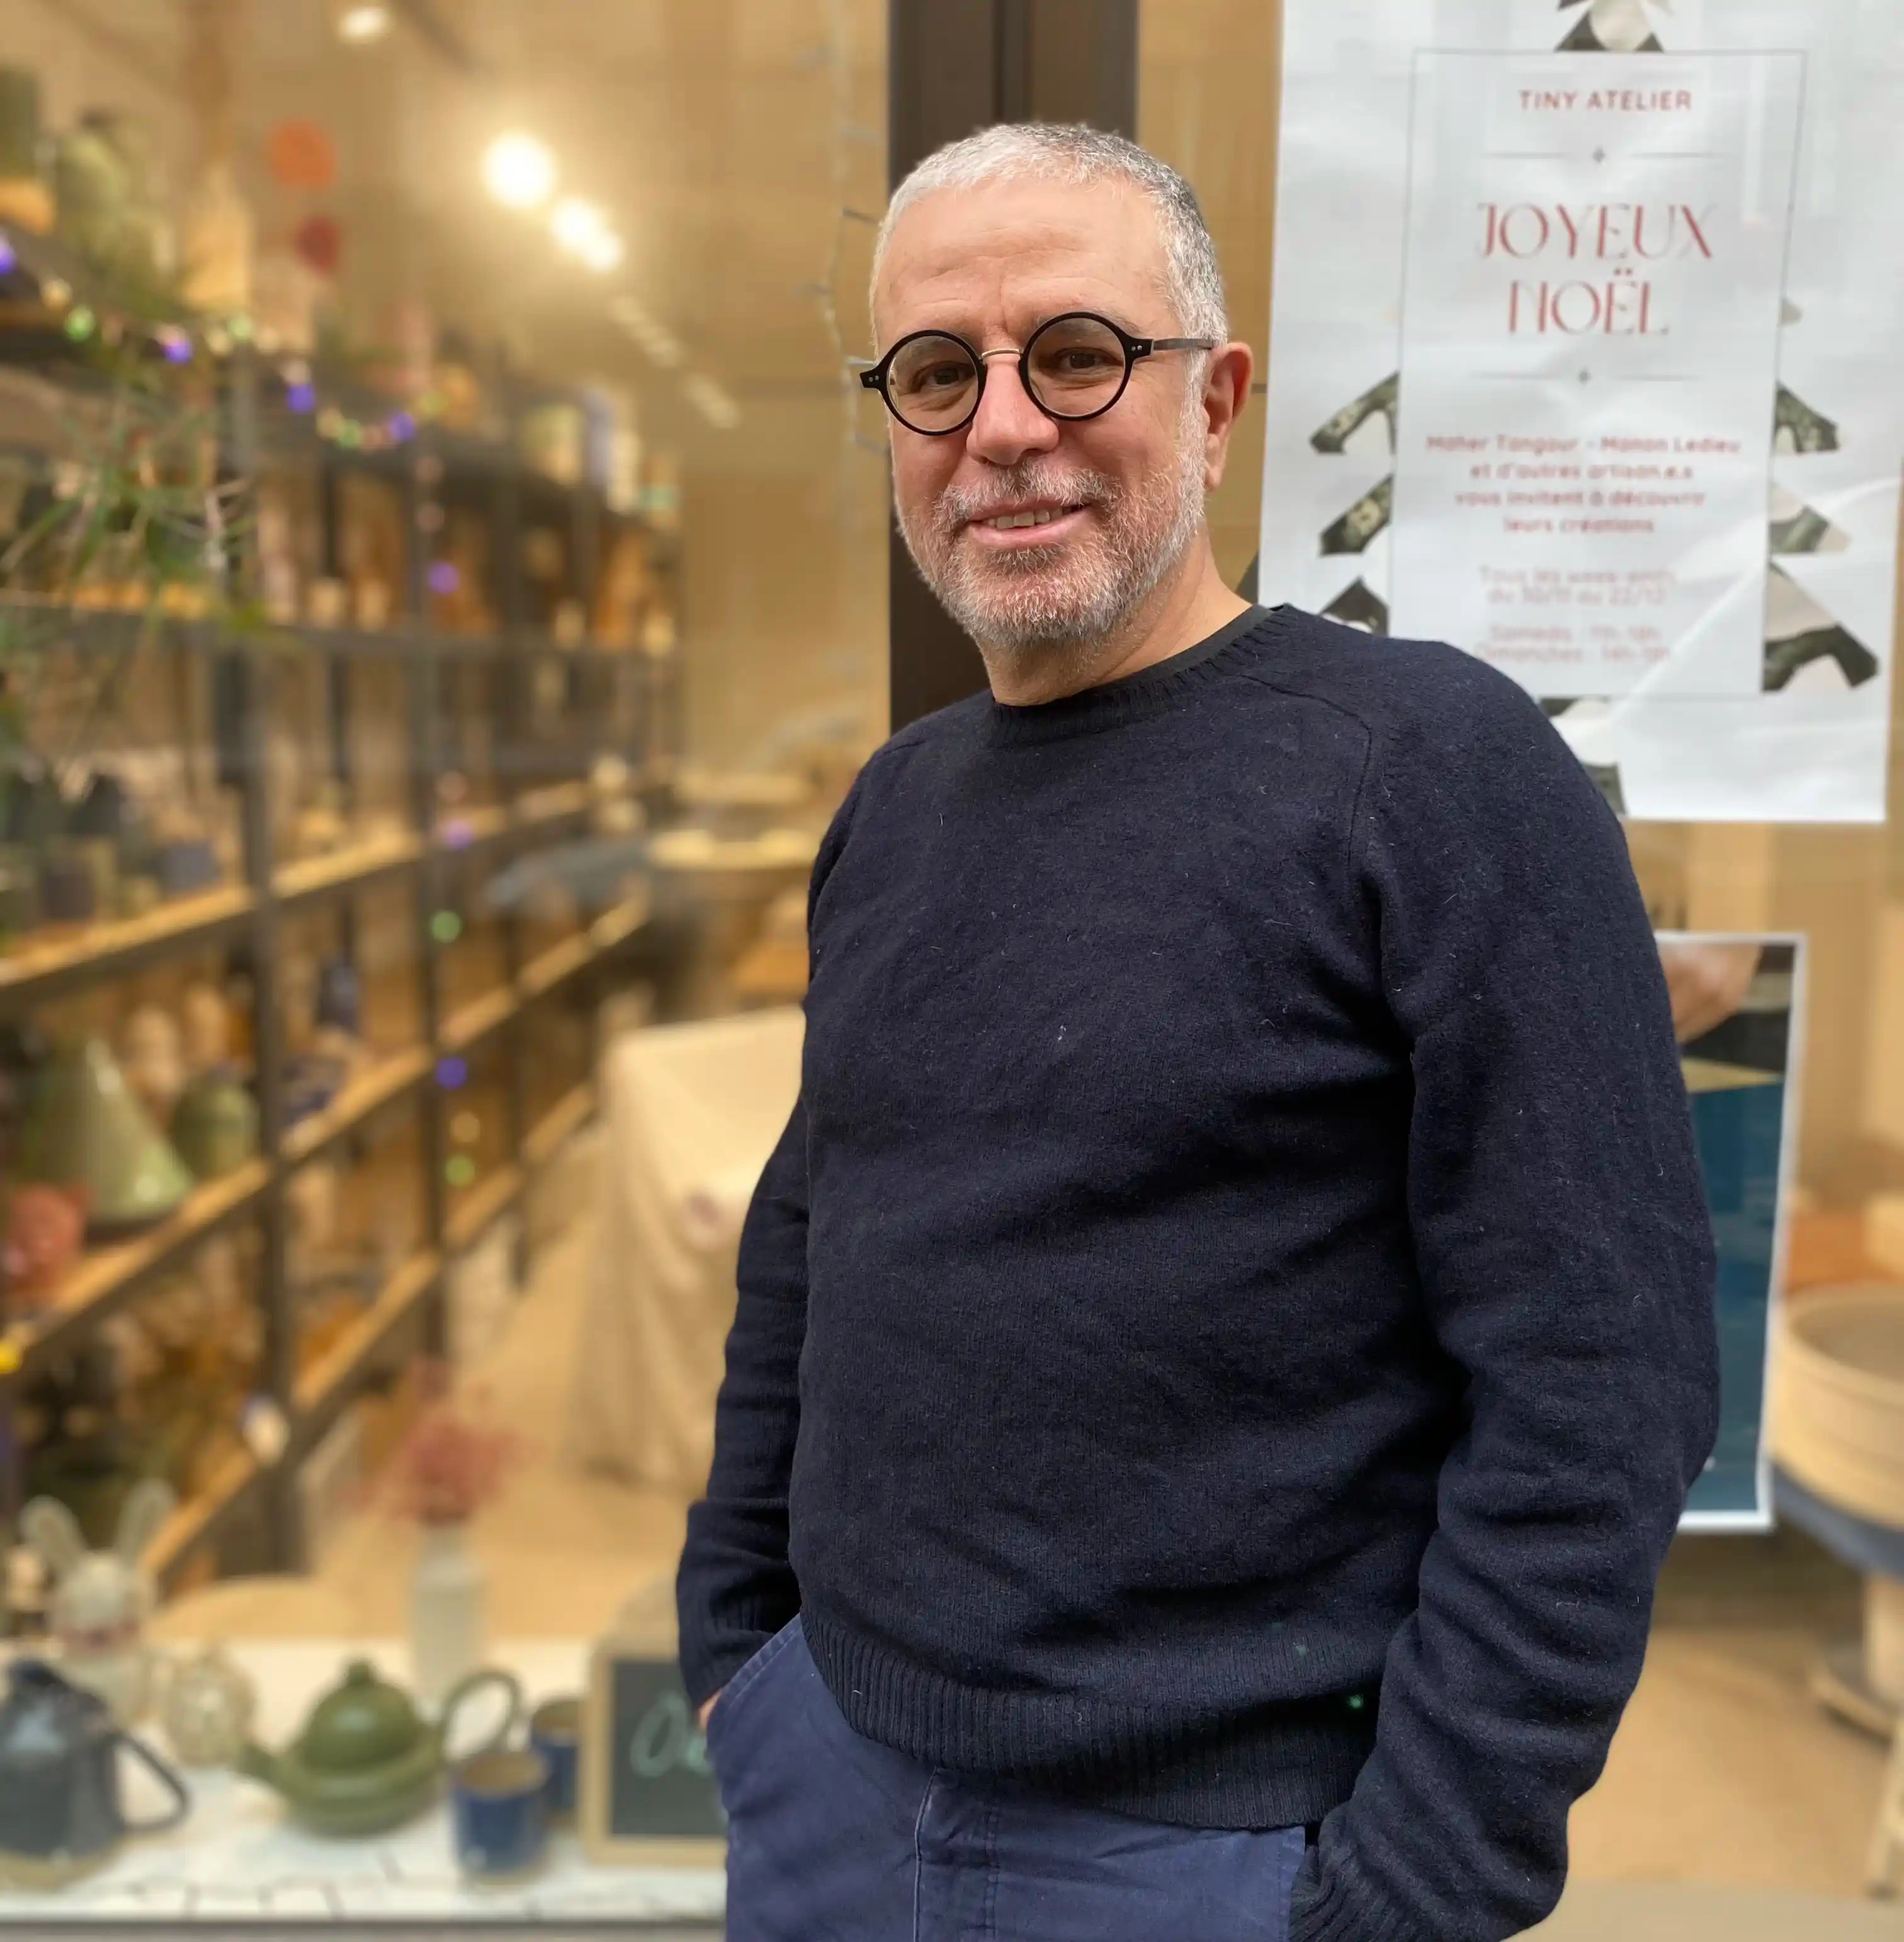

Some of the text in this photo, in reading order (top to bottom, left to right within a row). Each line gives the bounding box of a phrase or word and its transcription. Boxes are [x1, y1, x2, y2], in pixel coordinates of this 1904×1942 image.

[1519, 89, 1692, 111] TINY ATELIER
[1475, 202, 1718, 259] JOYEUX
[1509, 268, 1670, 335] NOËL
[1600, 436, 1668, 452] Manon
[1470, 464, 1490, 479] et
[1454, 492, 1501, 506] vous
